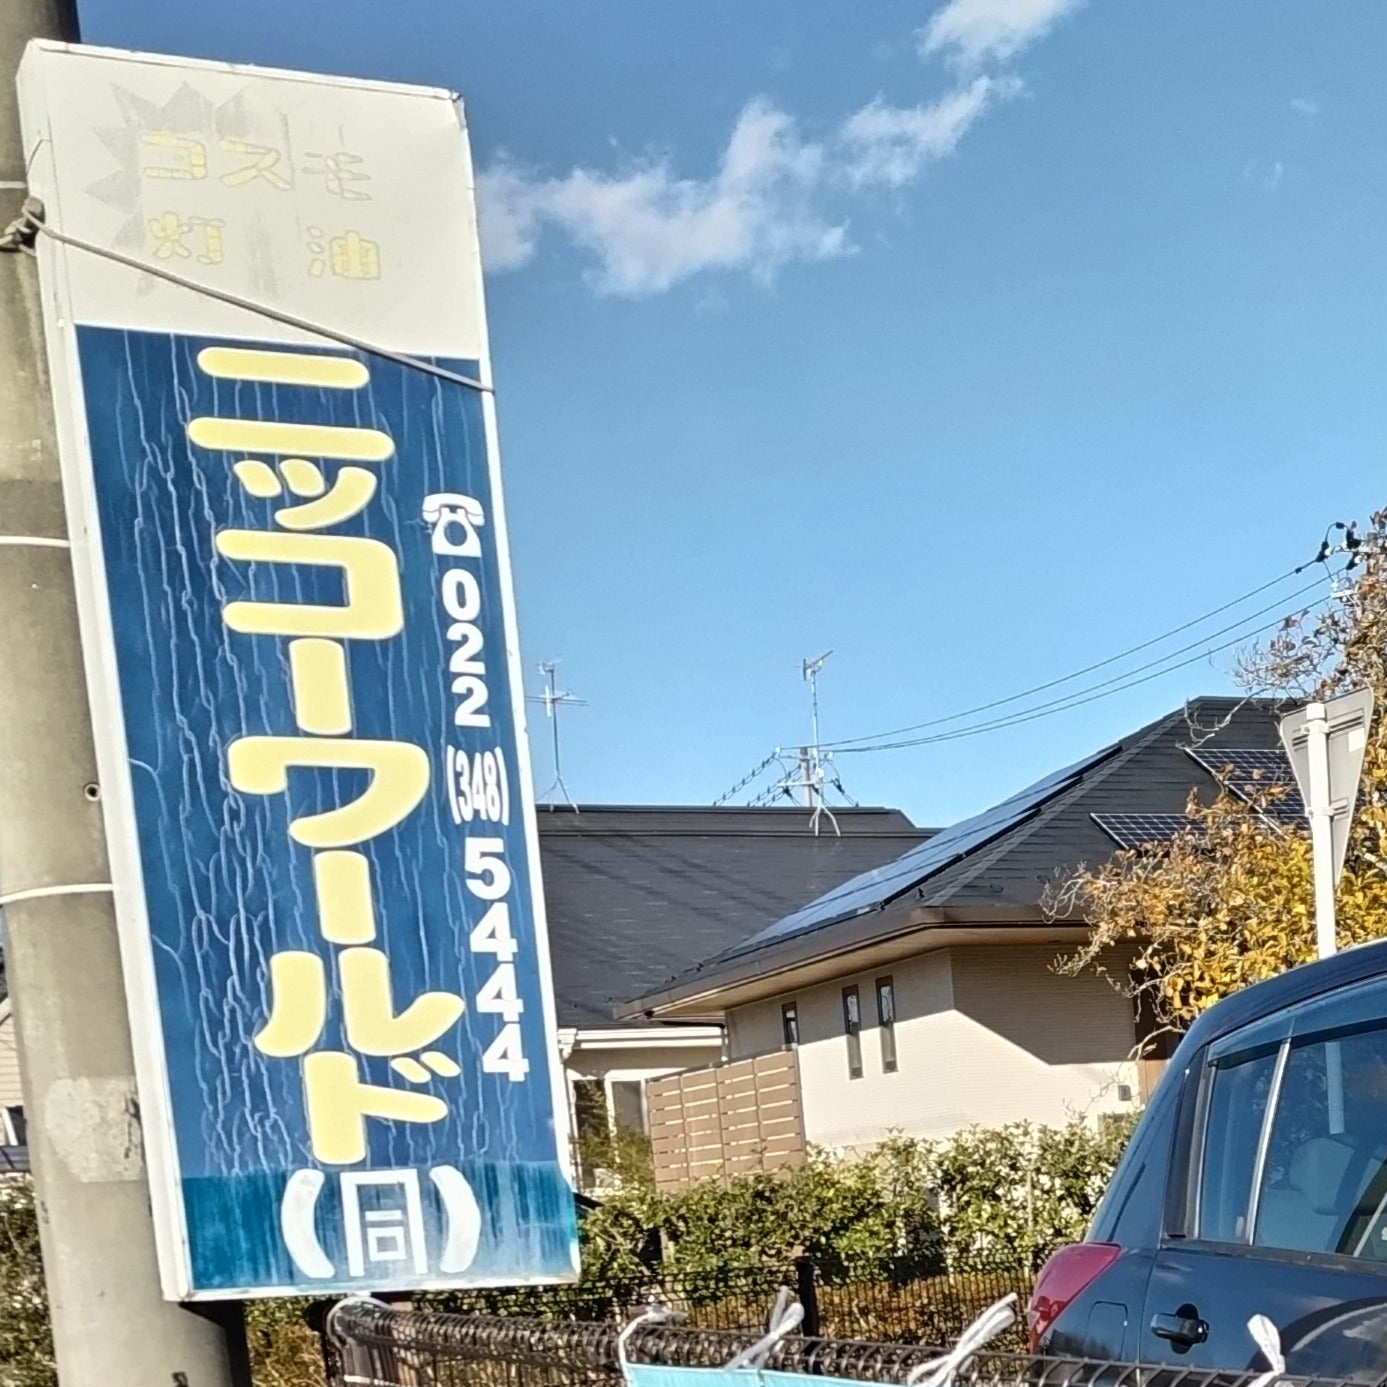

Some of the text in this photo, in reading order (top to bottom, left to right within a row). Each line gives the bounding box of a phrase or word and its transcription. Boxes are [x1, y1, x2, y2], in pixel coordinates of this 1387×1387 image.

[186, 345, 466, 1166] ニッコーワールド
[281, 1164, 482, 1279] (同)
